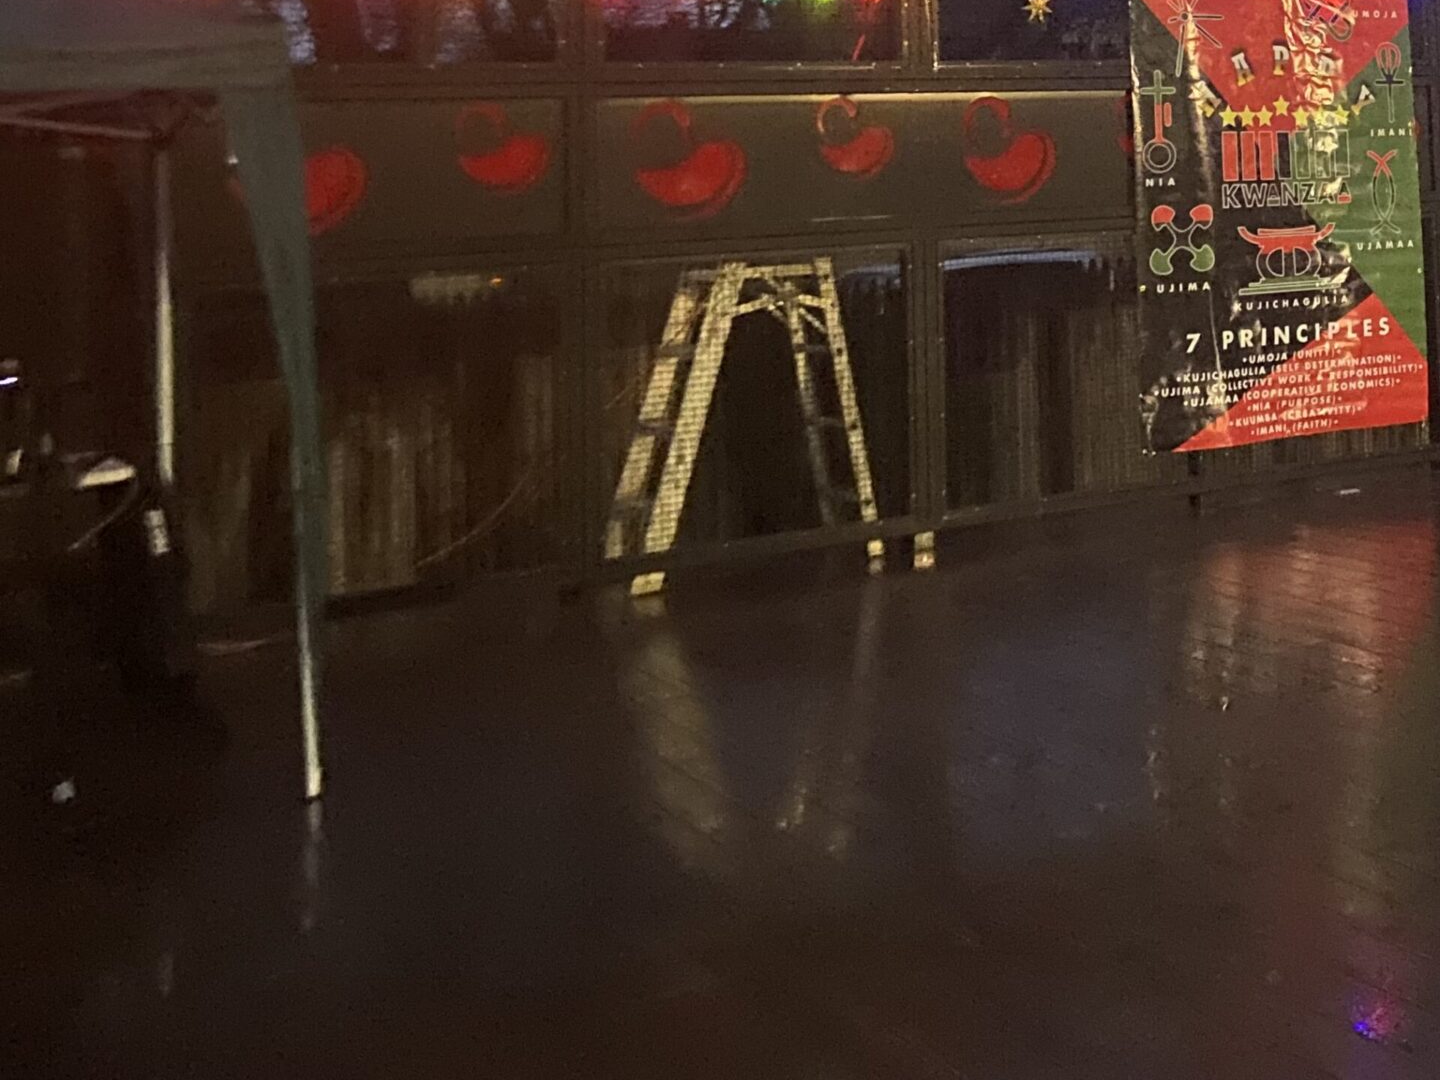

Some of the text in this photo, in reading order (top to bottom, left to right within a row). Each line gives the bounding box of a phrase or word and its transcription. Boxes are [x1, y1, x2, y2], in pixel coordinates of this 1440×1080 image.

[1352, 9, 1397, 19] UMOJA
[1370, 127, 1413, 138] IMANI
[1145, 177, 1176, 188] NIA
[1221, 177, 1352, 209] KWANZAA
[1356, 239, 1415, 251] UJAMAA
[1156, 281, 1211, 294] UJIMA
[1237, 294, 1350, 312] KUJICHAGULIA
[1185, 316, 1392, 354] 7 PRINCIPLES
[1248, 351, 1289, 364] UMOJA
[1182, 366, 1267, 383] KUJICHAGULIA
[1304, 353, 1397, 372] DETERMINATION)
[1160, 385, 1201, 398] UJIMA
[1278, 373, 1311, 386] WORK
[1328, 363, 1418, 381] RESPONSIBILITY)
[1189, 377, 1395, 408] UJAMAA (COOPERATIVE ECONOMICS)
[1252, 395, 1336, 412] NIA (PURPOSE)
[1235, 412, 1278, 428] KUUMBA
[1292, 419, 1332, 433] (FAITH)
